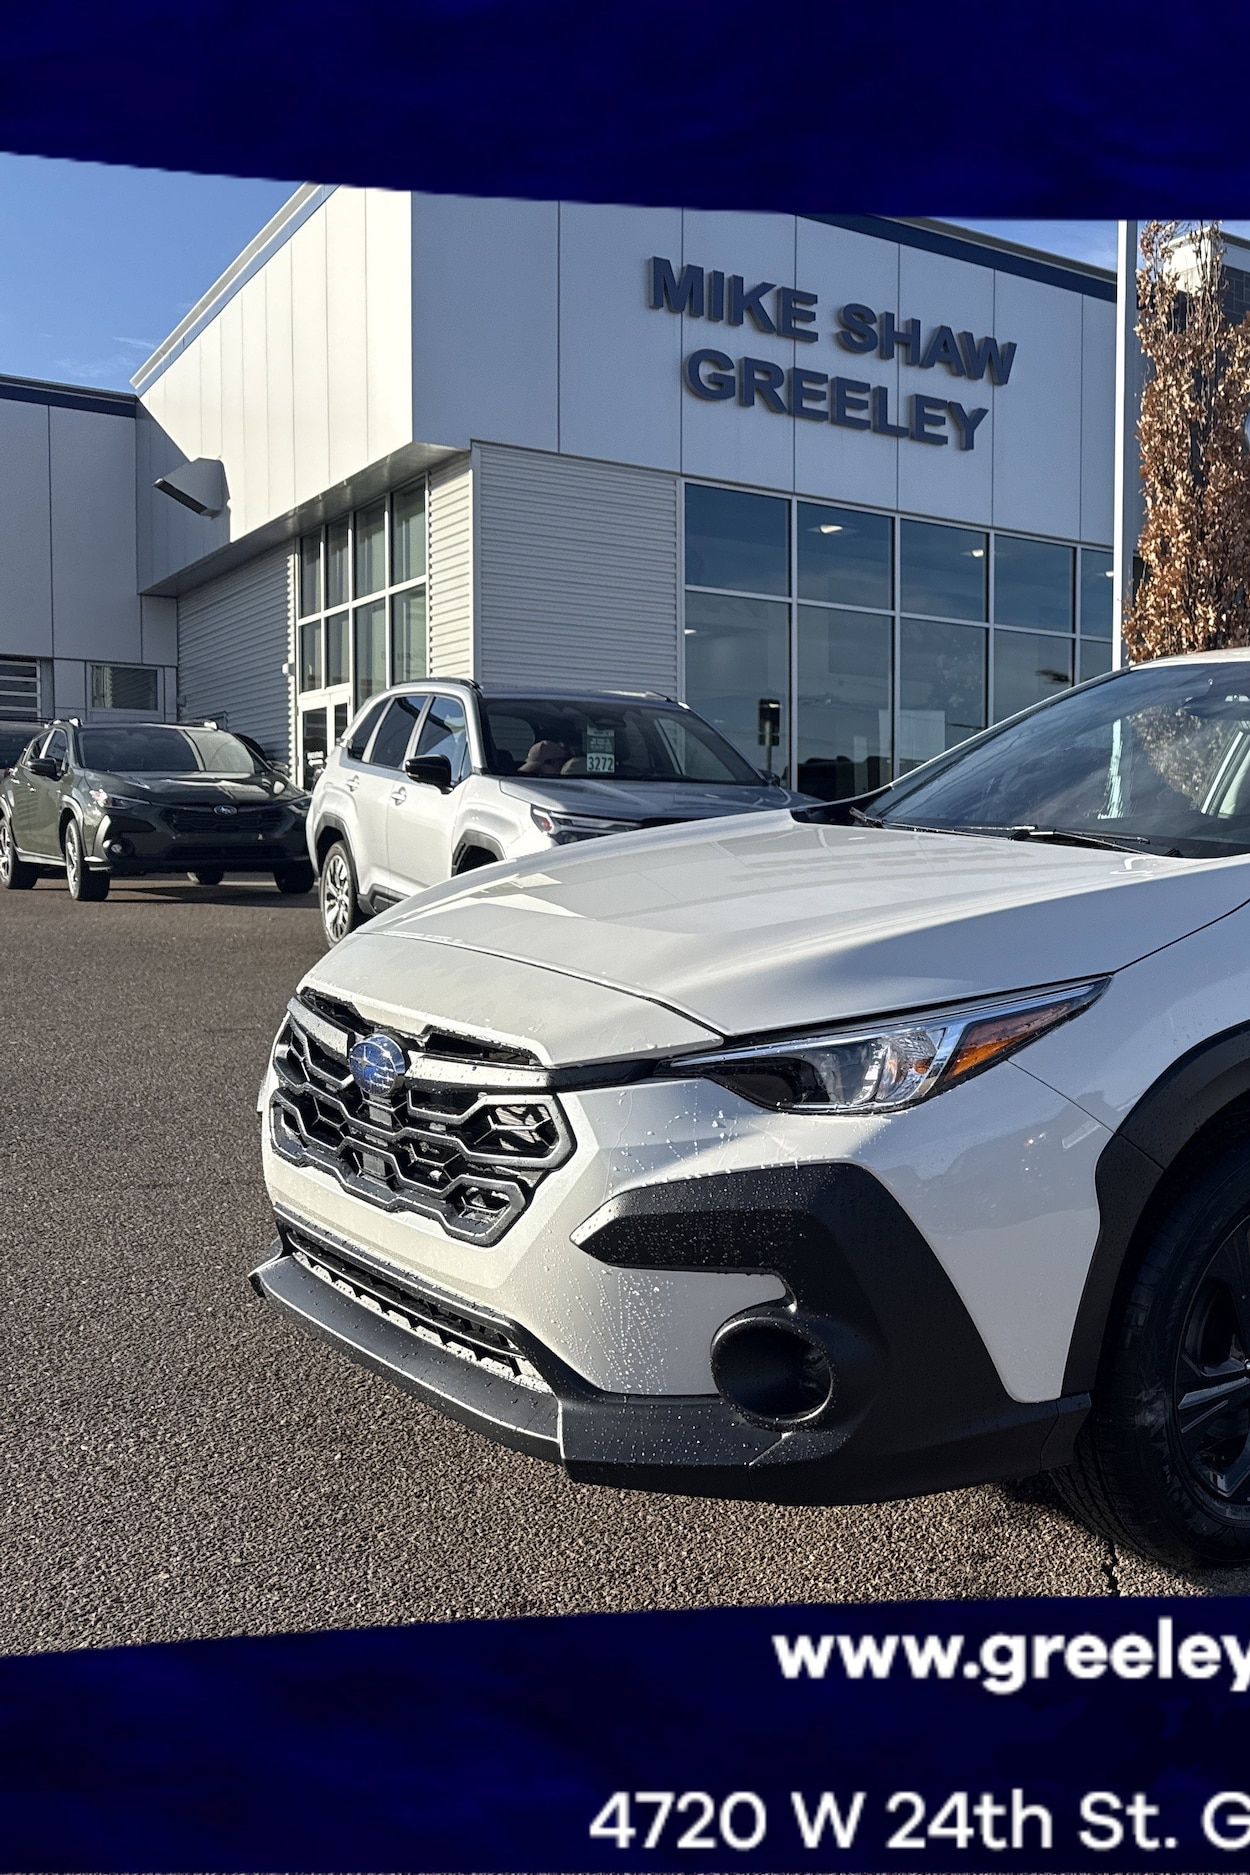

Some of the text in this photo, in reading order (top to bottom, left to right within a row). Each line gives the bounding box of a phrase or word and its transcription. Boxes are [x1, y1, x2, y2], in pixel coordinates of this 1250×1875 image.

[648, 256, 1017, 386] MIKE SHAW
[685, 348, 989, 451] GREELEY
[588, 755, 614, 771] 3272
